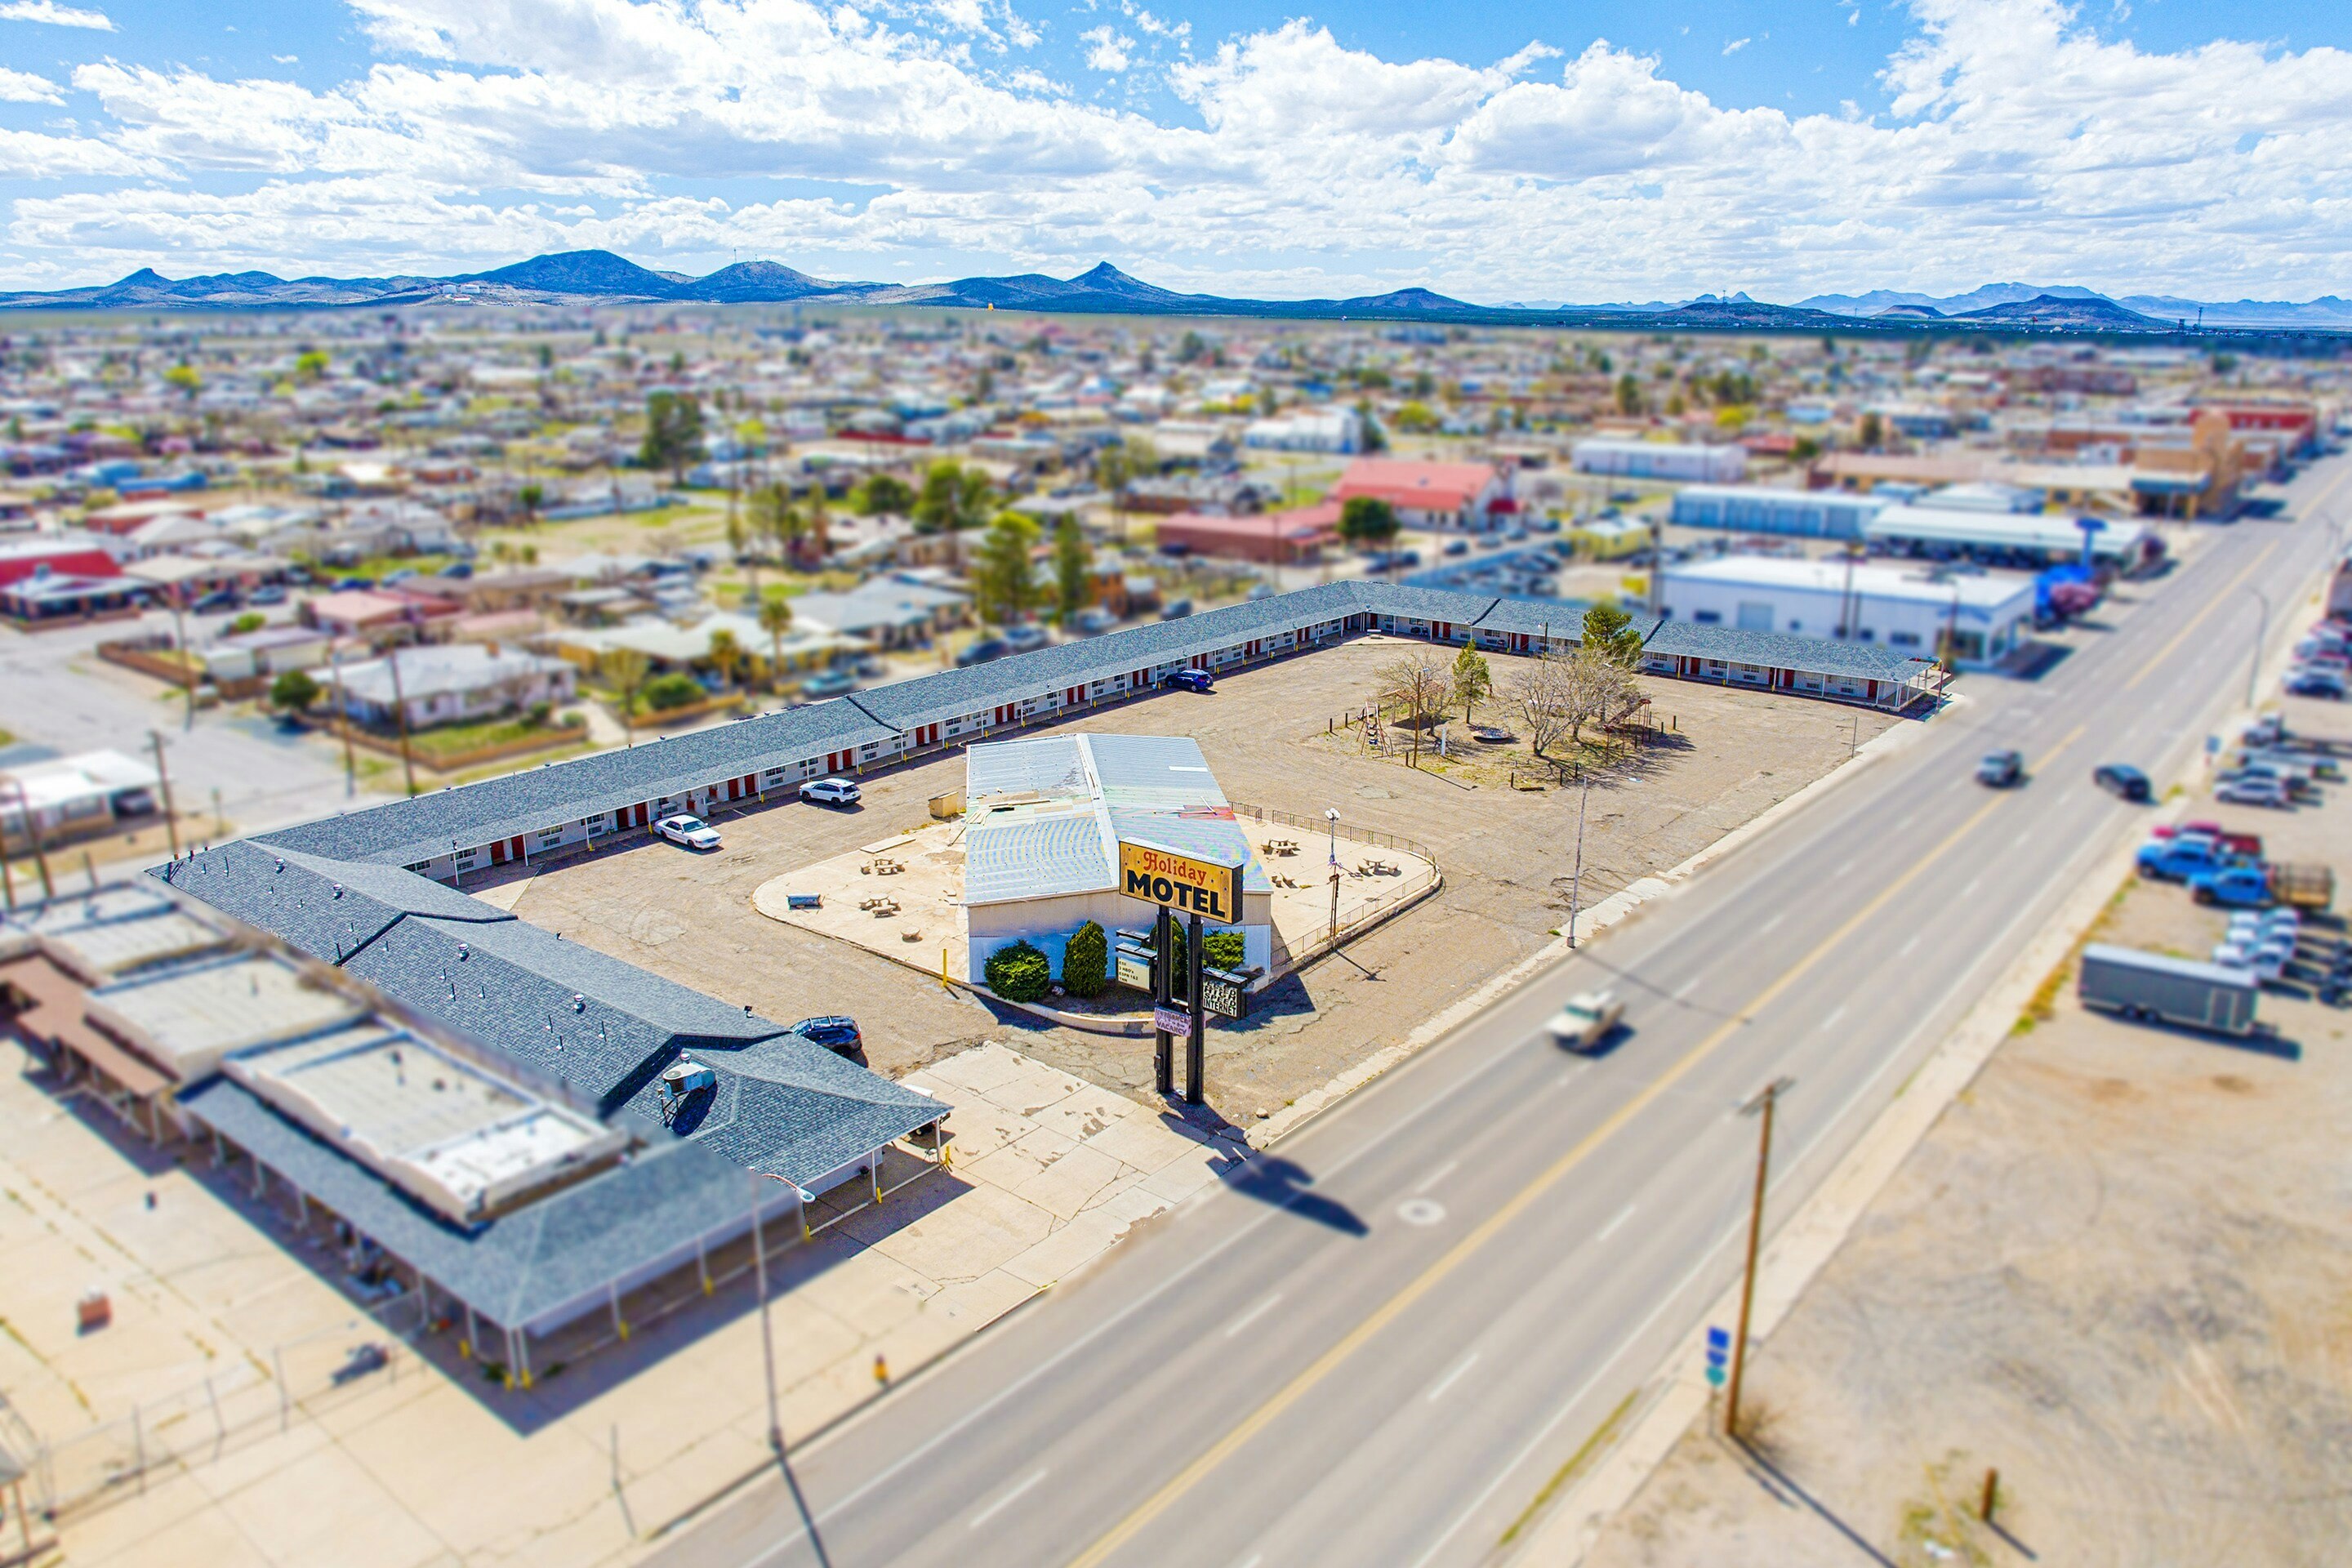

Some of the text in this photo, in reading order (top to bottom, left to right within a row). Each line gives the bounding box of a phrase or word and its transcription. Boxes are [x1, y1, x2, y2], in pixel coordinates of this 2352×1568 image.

[1143, 851, 1207, 886] Holiday
[1127, 869, 1226, 918] MOTEL
[1205, 985, 1236, 1000] HIGH
[1205, 993, 1236, 1006] SPEED
[1203, 998, 1236, 1016] INTERNET
[1156, 1020, 1187, 1036] VACANCY
